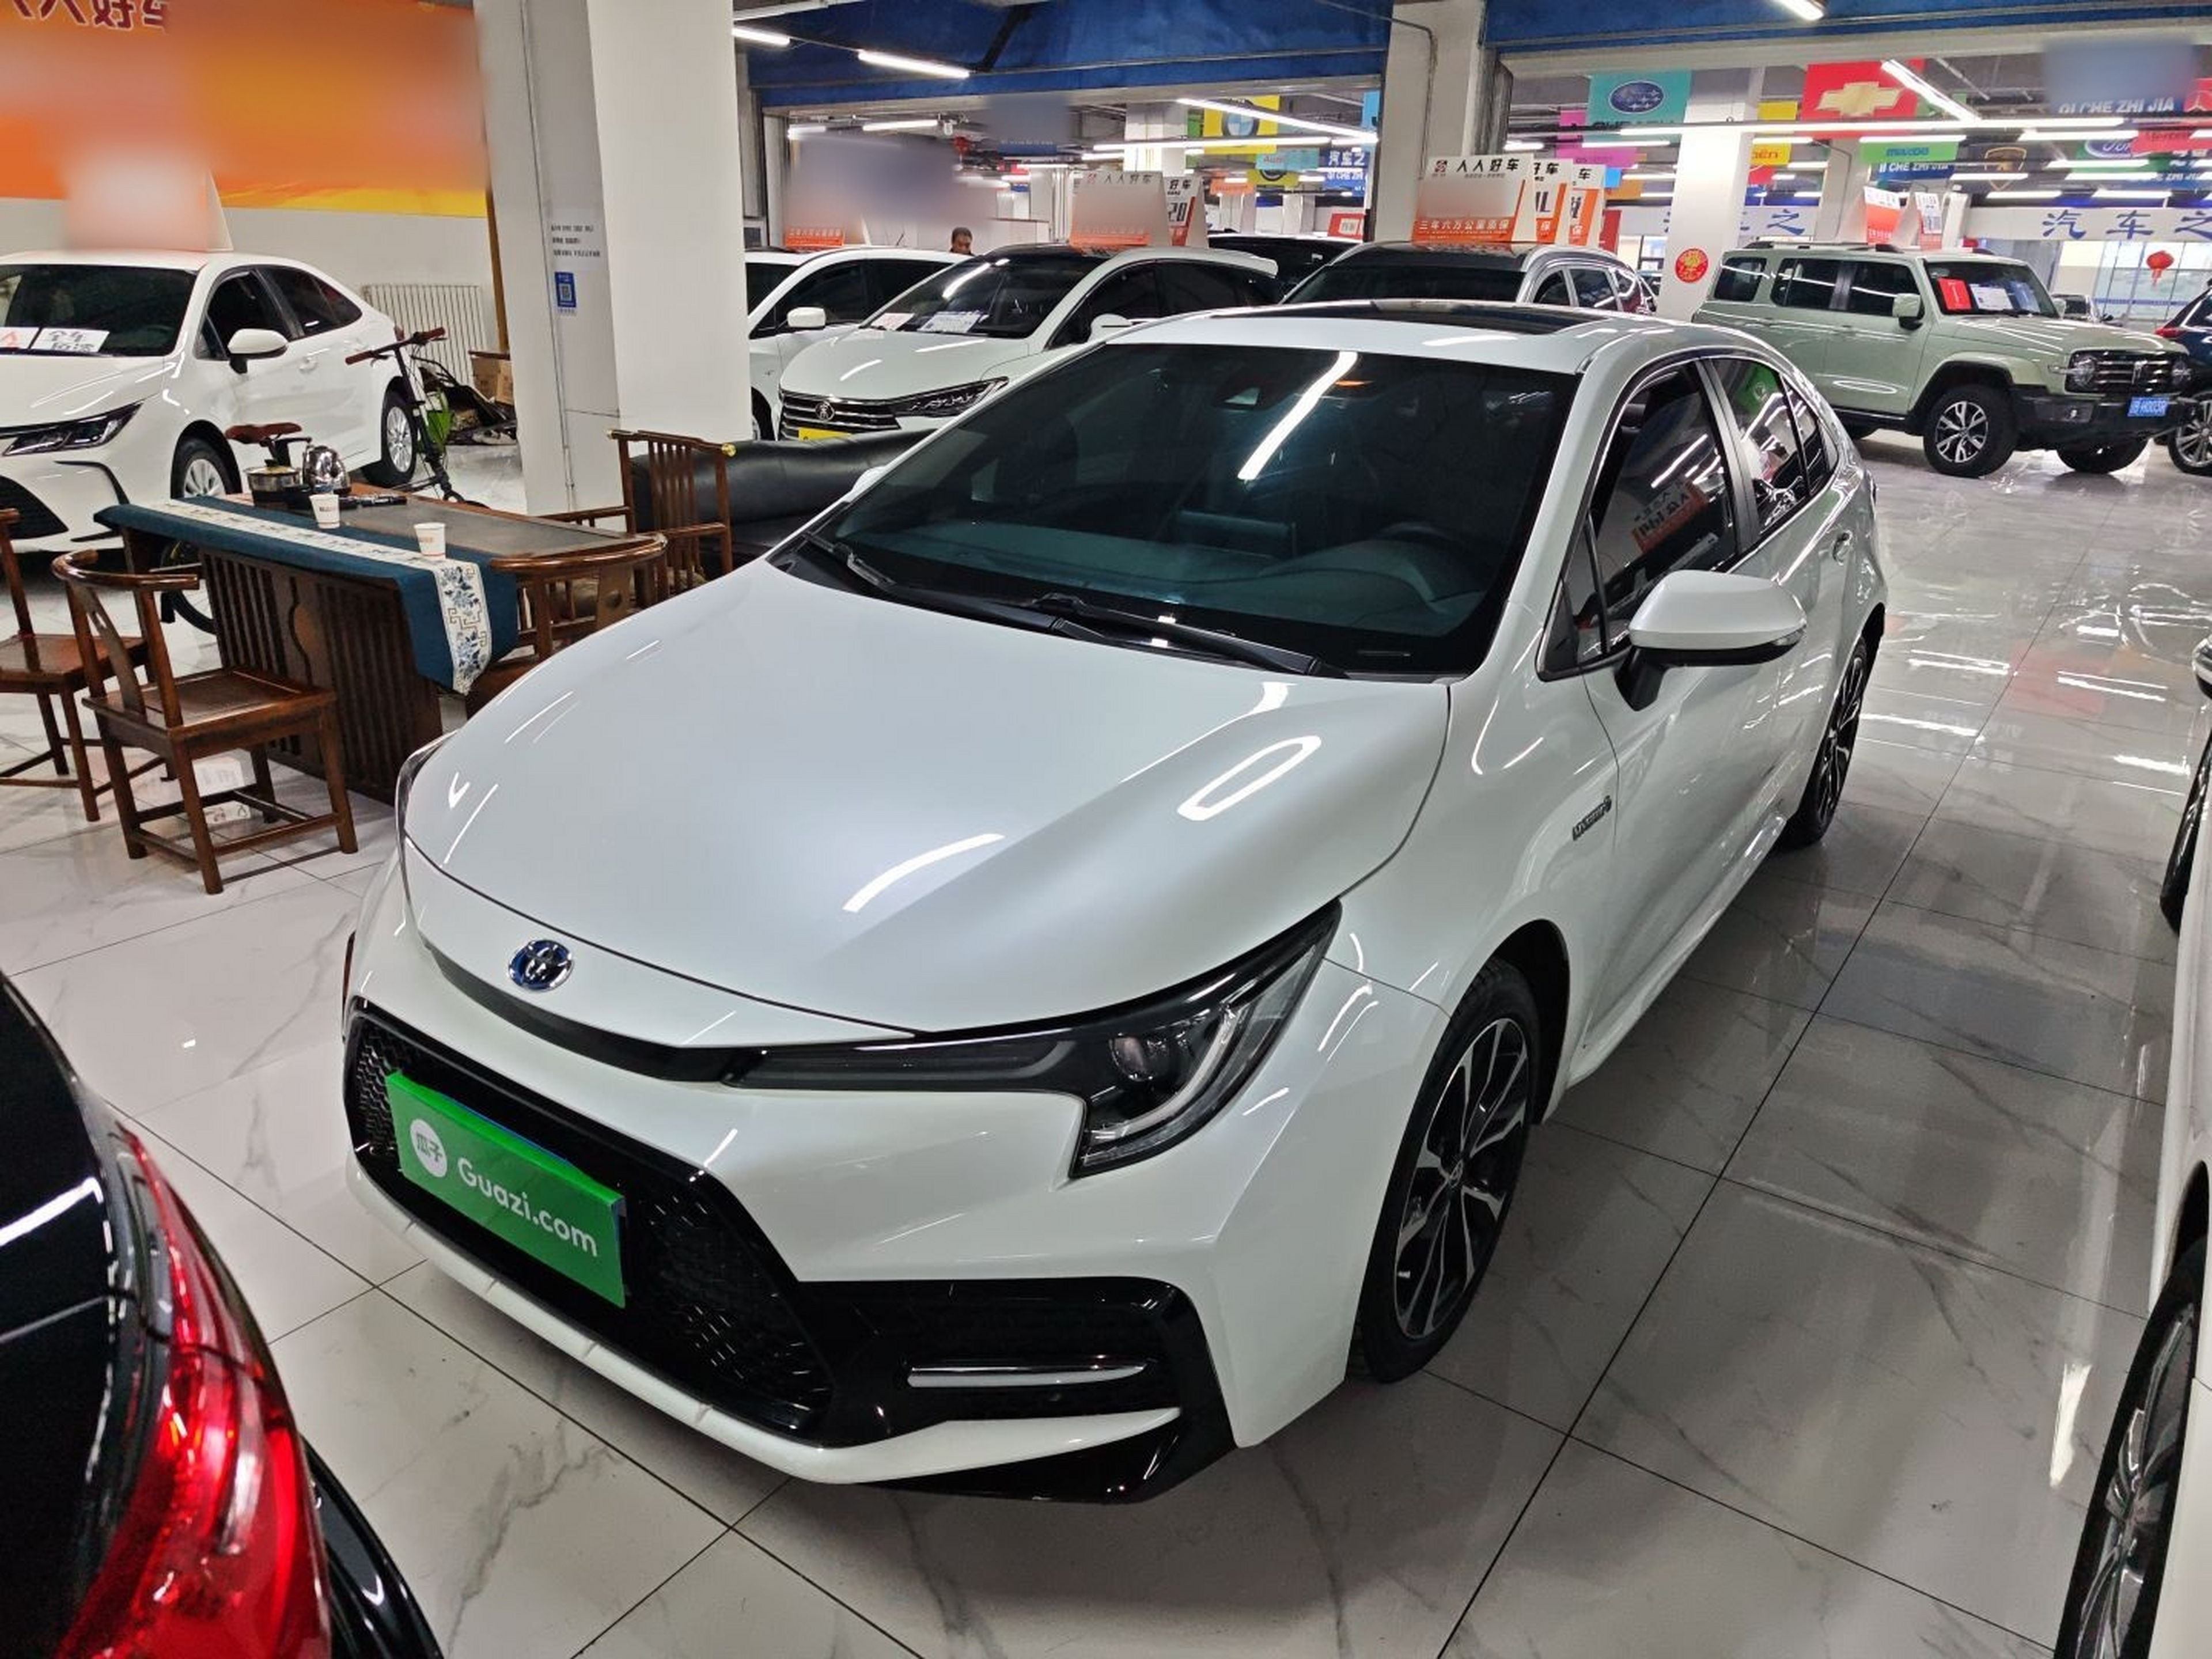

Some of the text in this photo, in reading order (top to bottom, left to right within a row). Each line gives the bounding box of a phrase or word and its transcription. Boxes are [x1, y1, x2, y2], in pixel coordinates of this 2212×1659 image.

[2115, 98, 2145, 113] ZHI
[2146, 96, 2175, 112] JIA
[1456, 157, 1520, 172] 人人好车
[415, 1132, 443, 1162] 瓜子
[456, 1157, 598, 1257] Guazi.com
